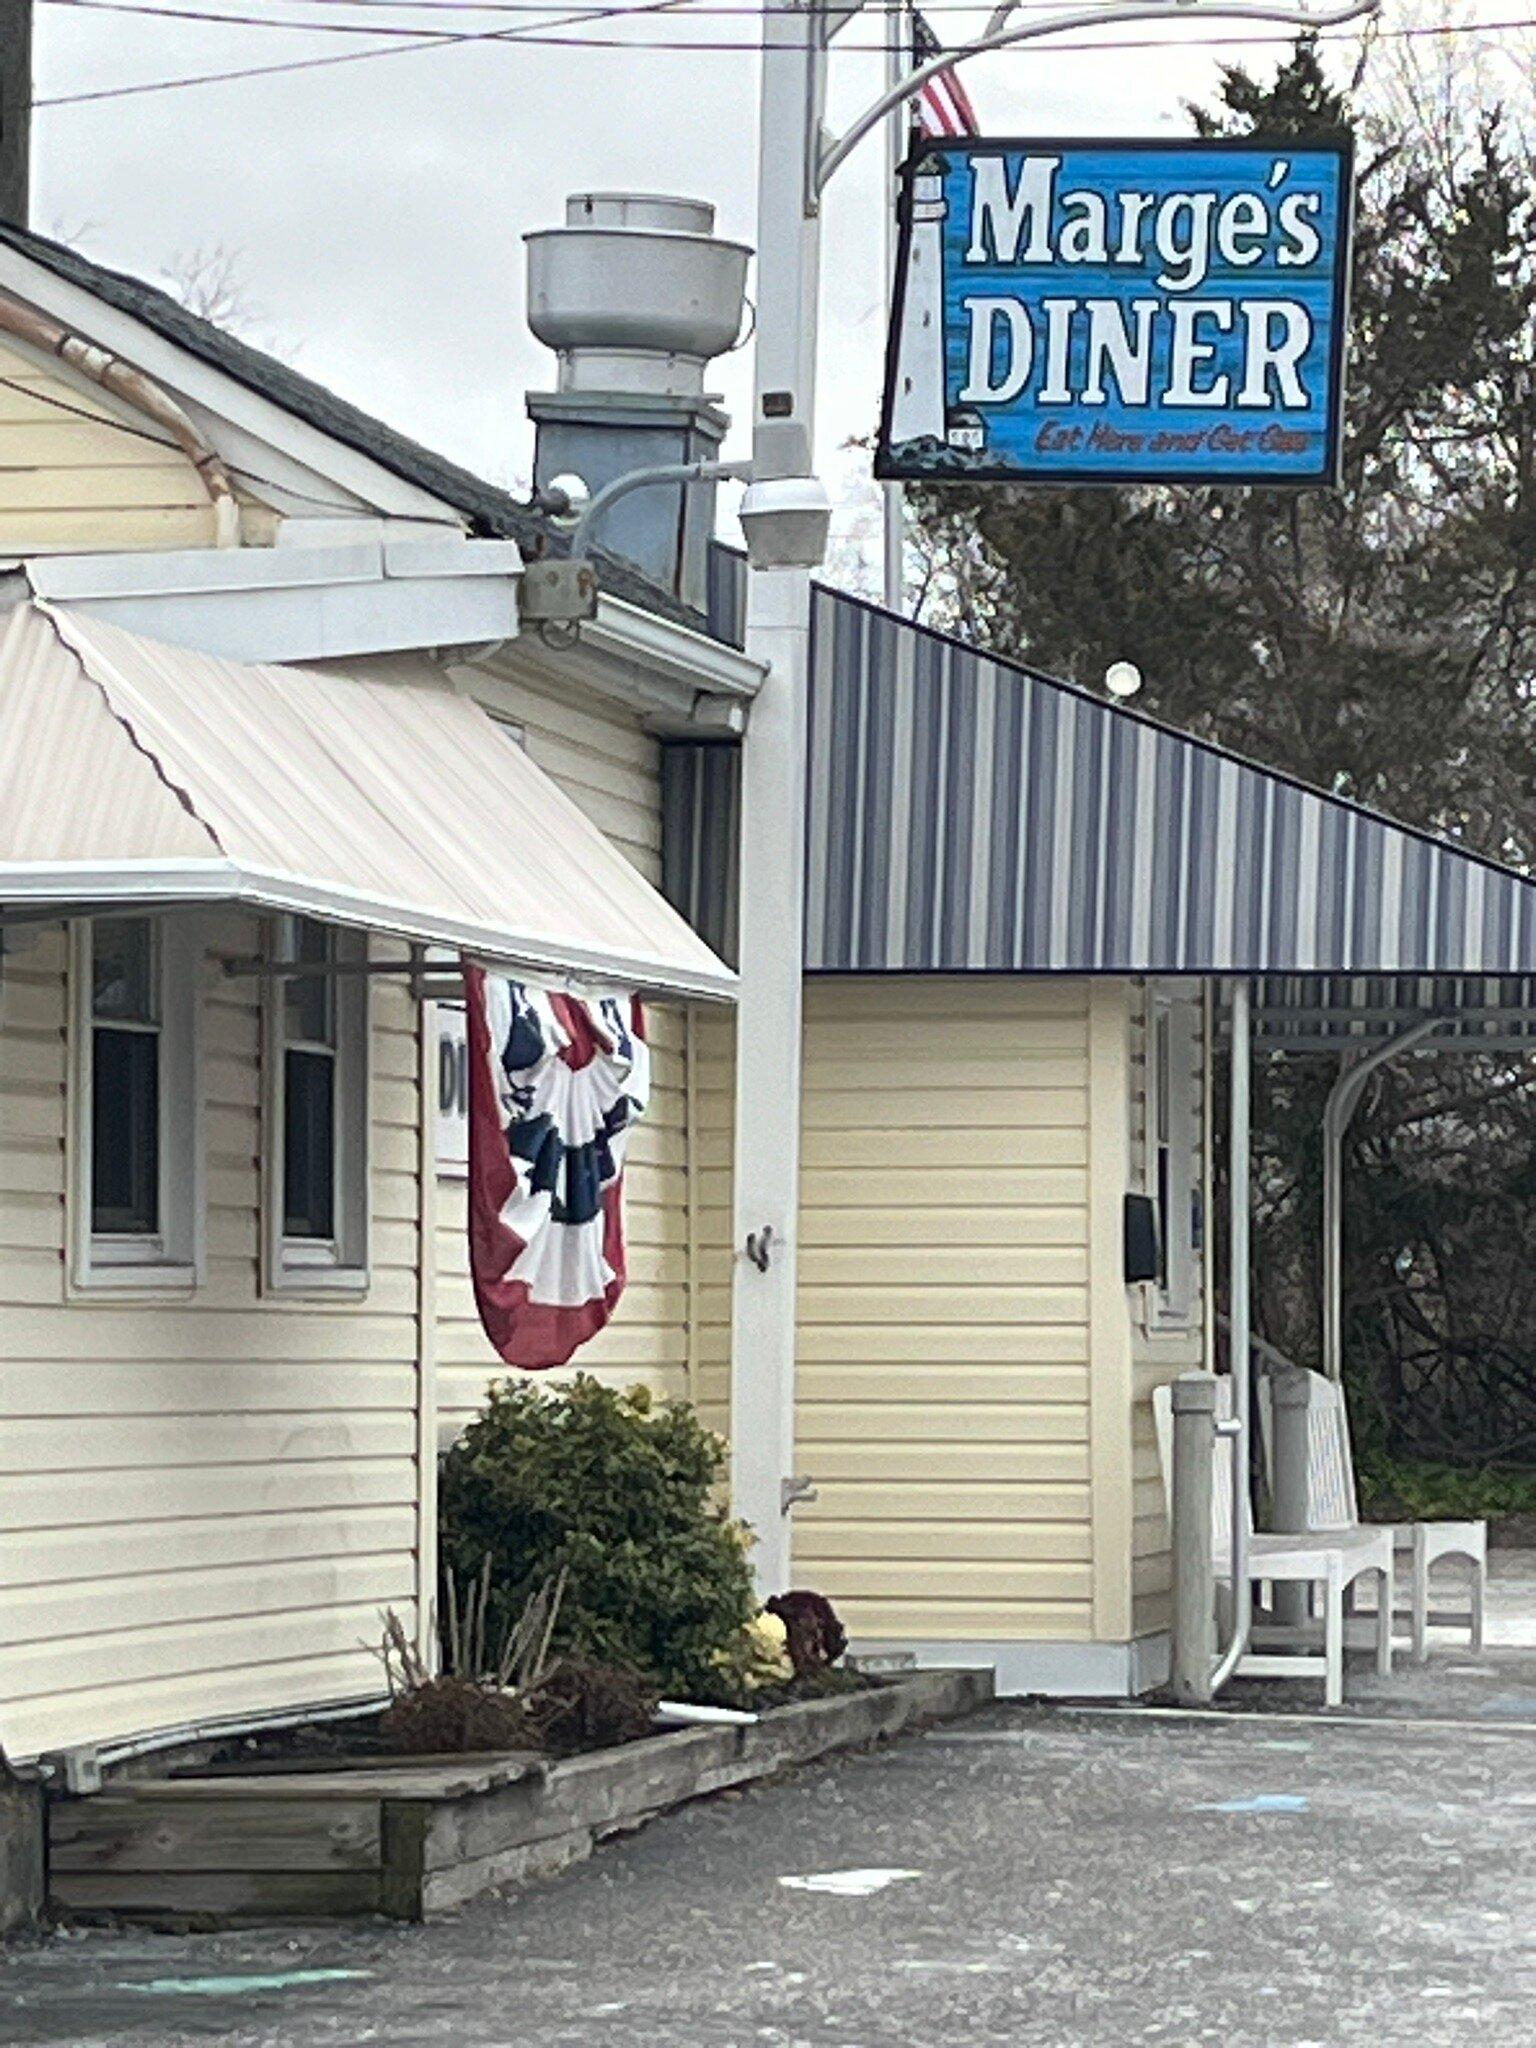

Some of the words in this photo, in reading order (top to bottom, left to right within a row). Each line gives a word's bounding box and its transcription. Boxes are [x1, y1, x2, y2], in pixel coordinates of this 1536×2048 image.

[966, 156, 1321, 290] Marge's
[959, 299, 1313, 408] DINER
[1035, 421, 1083, 453] Eat
